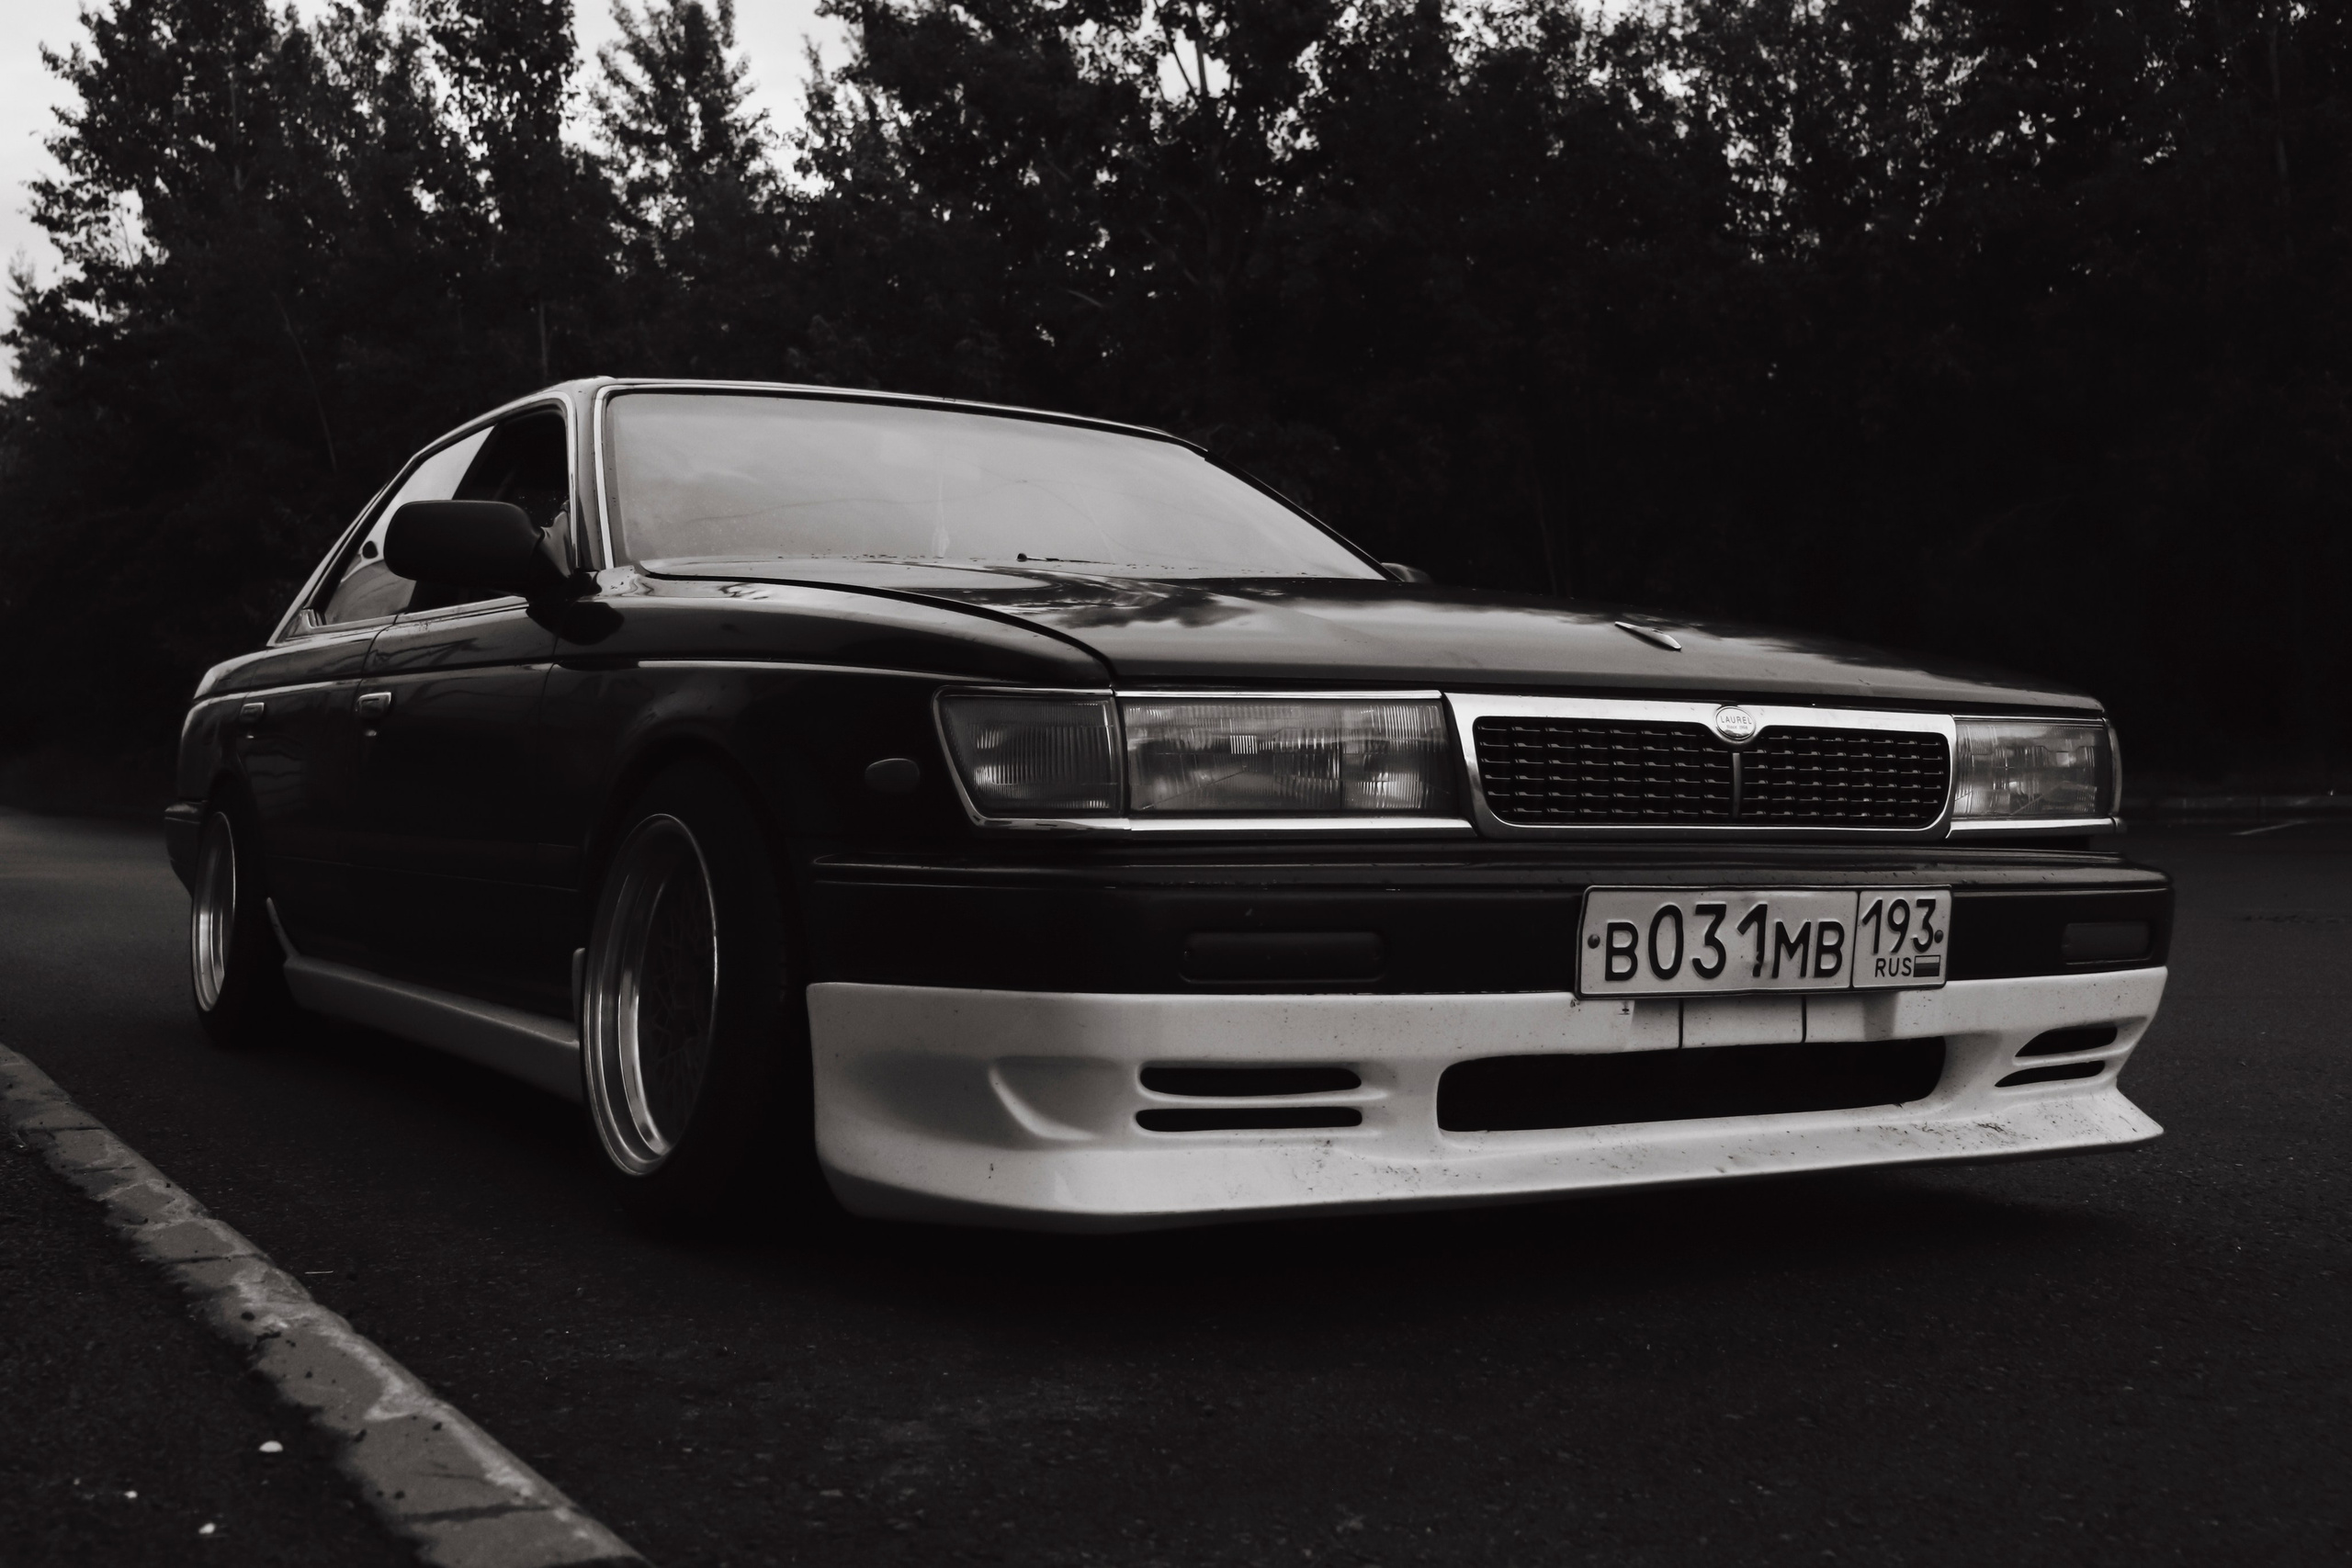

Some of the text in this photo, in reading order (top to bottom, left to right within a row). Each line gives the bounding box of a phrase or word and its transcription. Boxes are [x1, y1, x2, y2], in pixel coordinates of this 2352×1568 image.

[1720, 716, 1752, 725] LAUREL
[1861, 898, 1936, 953] 193
[1875, 958, 1912, 977] RUS
